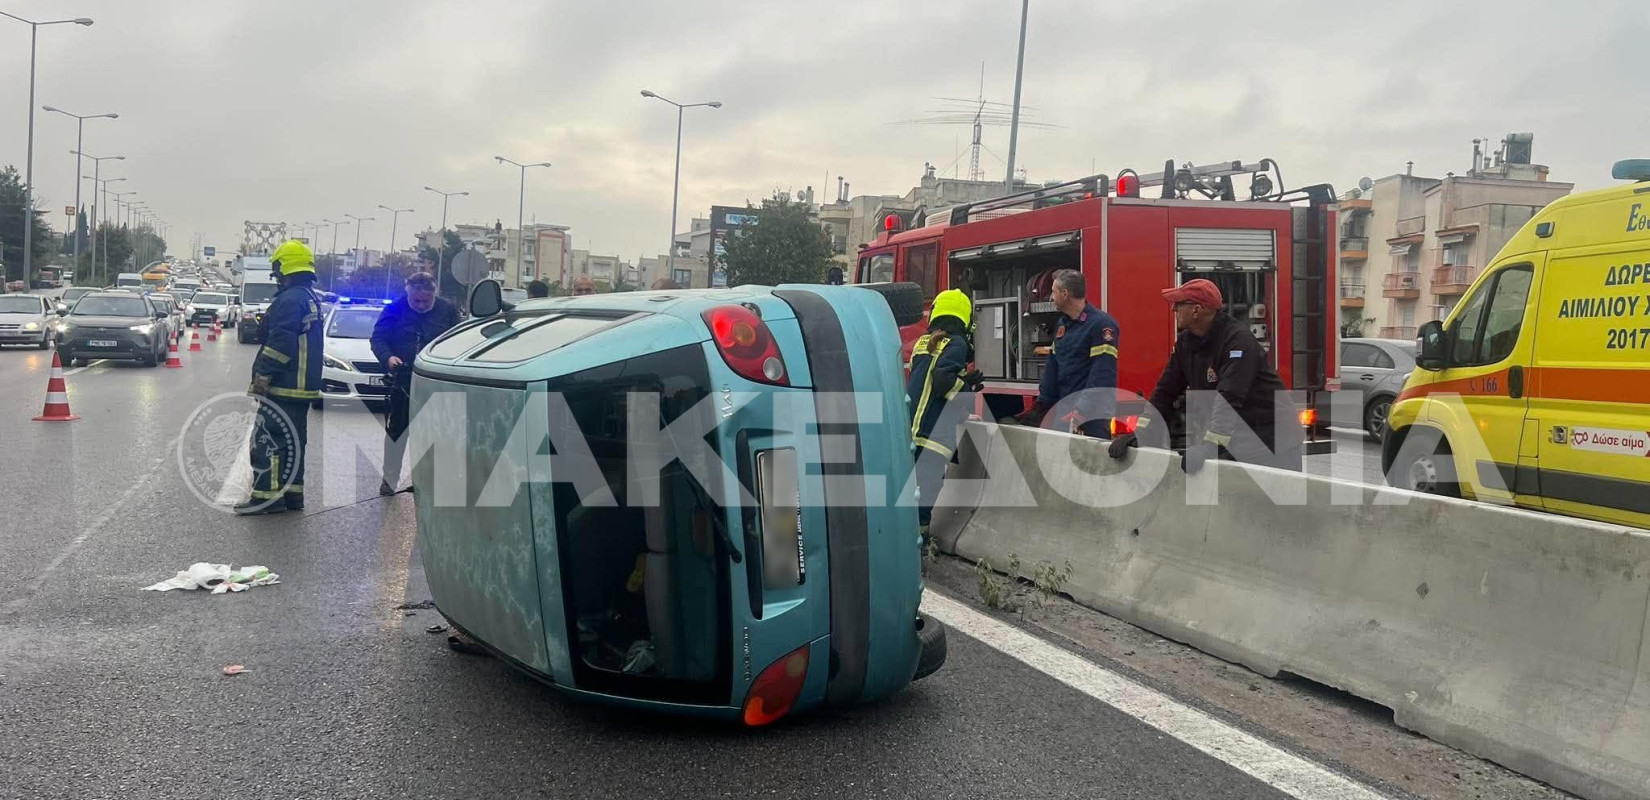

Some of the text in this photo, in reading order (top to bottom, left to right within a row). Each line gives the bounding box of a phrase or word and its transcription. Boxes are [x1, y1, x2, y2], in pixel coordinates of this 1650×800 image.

[1558, 296, 1640, 319] ΑΙΜΙΛΙΟΥ
[1606, 328, 1650, 349] 2017
[1482, 377, 1497, 392] 166
[1592, 433, 1644, 450] Δώσε αίμα
[797, 534, 806, 573] SERVICE
